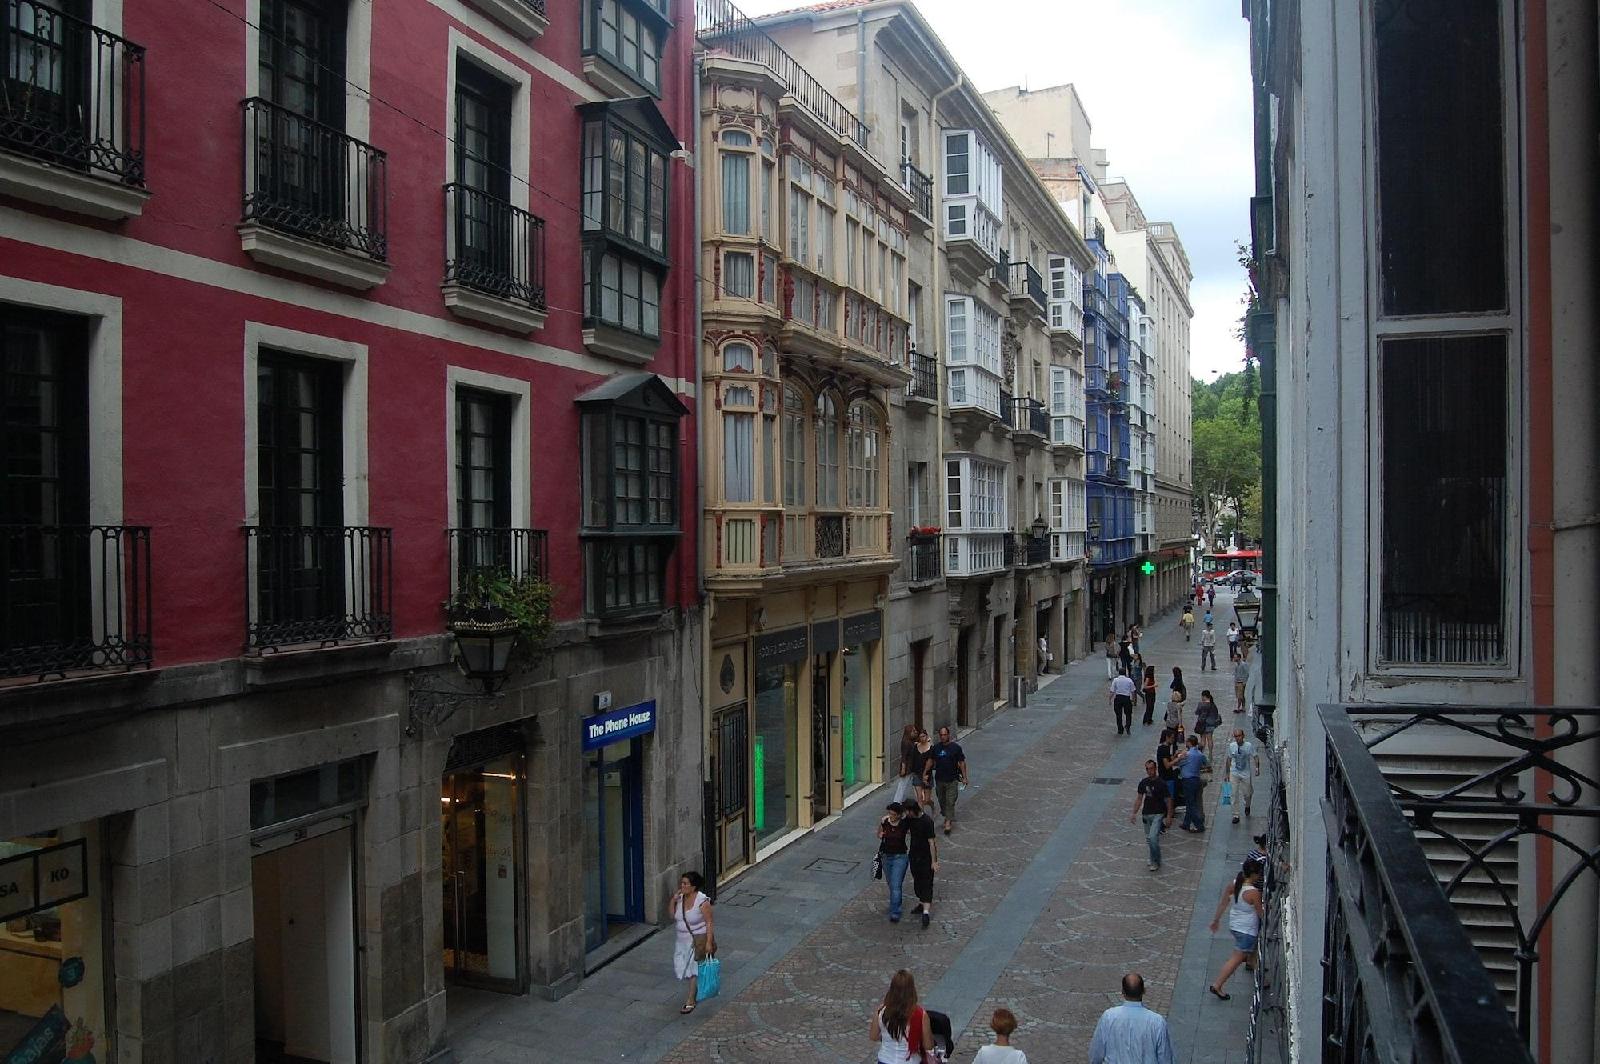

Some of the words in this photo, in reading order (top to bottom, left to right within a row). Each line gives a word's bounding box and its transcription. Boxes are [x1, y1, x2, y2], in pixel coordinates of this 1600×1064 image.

[588, 723, 604, 739] The
[605, 717, 629, 734] Phone
[629, 711, 651, 727] House
[50, 867, 70, 883] KO
